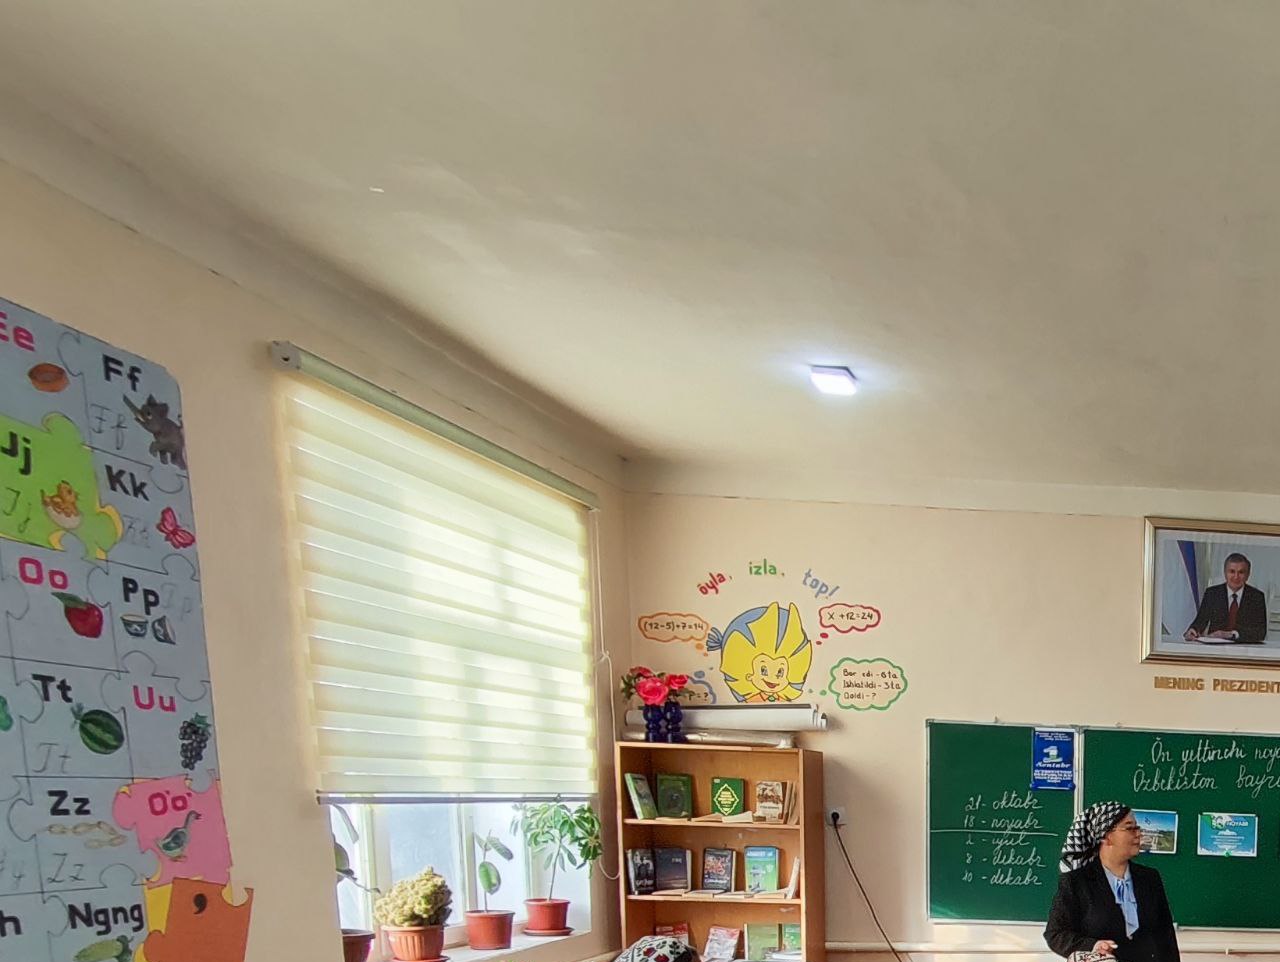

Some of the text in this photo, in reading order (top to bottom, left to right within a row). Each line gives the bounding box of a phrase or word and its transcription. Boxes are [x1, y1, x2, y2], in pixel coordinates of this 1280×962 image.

[102, 353, 143, 393] Ff
[0, 430, 32, 476] Jj
[104, 463, 150, 502] Kk
[18, 556, 69, 590] Oo
[121, 576, 160, 617] Pp
[31, 673, 74, 704] Tt
[132, 684, 177, 713] Uu
[1154, 676, 1205, 691] MENING
[47, 789, 92, 817] Zz
[992, 790, 1044, 809] oktabr
[964, 814, 976, 828] 18
[992, 847, 1047, 868] dekabr
[990, 867, 1043, 886] dekabr
[67, 901, 145, 937] Ngng
